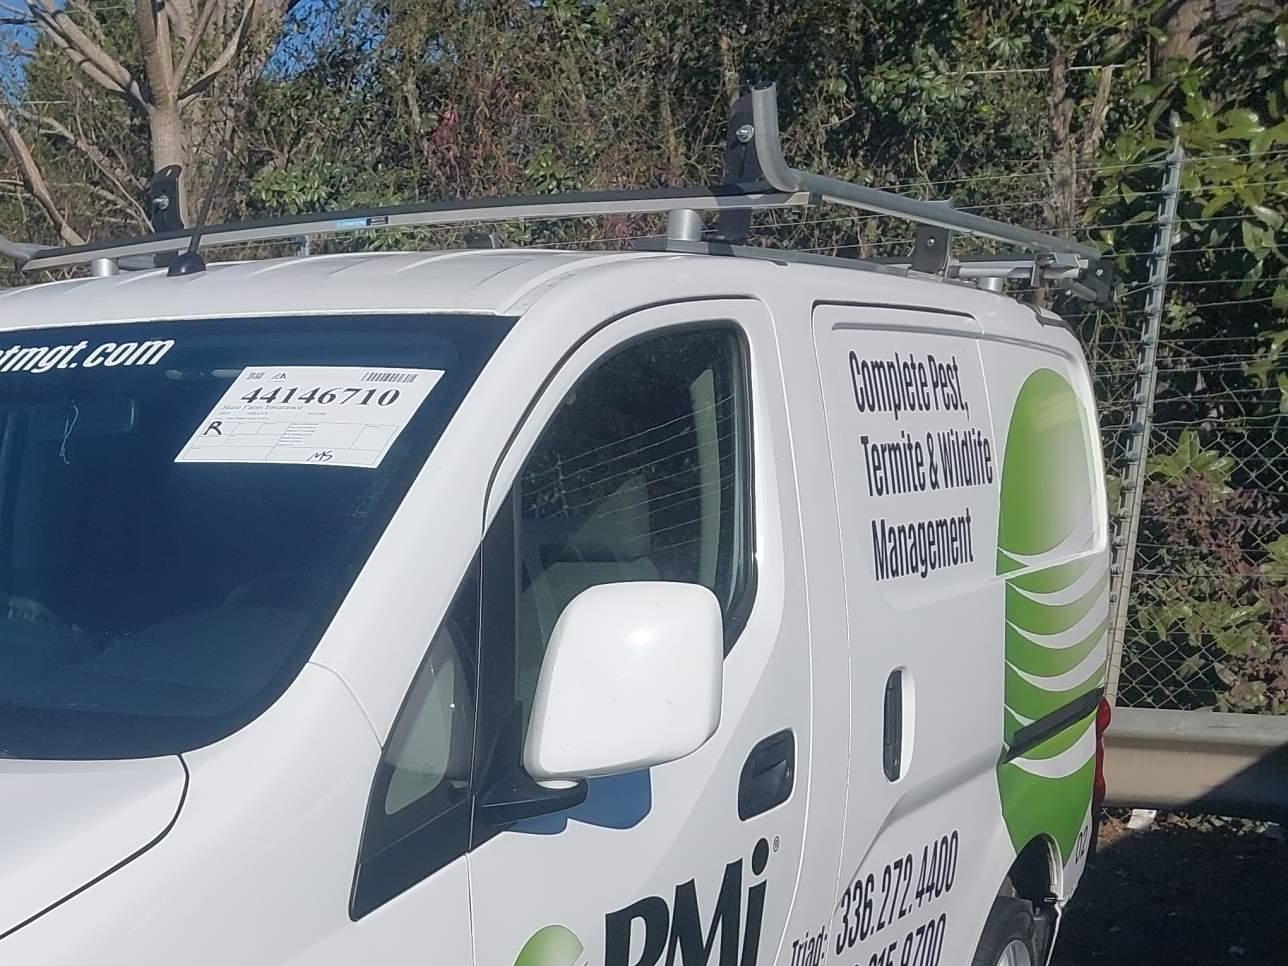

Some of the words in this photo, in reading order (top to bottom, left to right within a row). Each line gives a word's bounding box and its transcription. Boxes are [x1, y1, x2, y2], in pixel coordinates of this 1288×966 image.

[242, 387, 400, 406] 44146710
[849, 350, 930, 420] Complete
[927, 354, 970, 421] Pest,
[861, 431, 926, 496] Termite
[927, 432, 939, 490] &
[937, 428, 994, 488] Wildlife
[871, 507, 974, 581] Management
[835, 830, 959, 956] 336.272.4400
